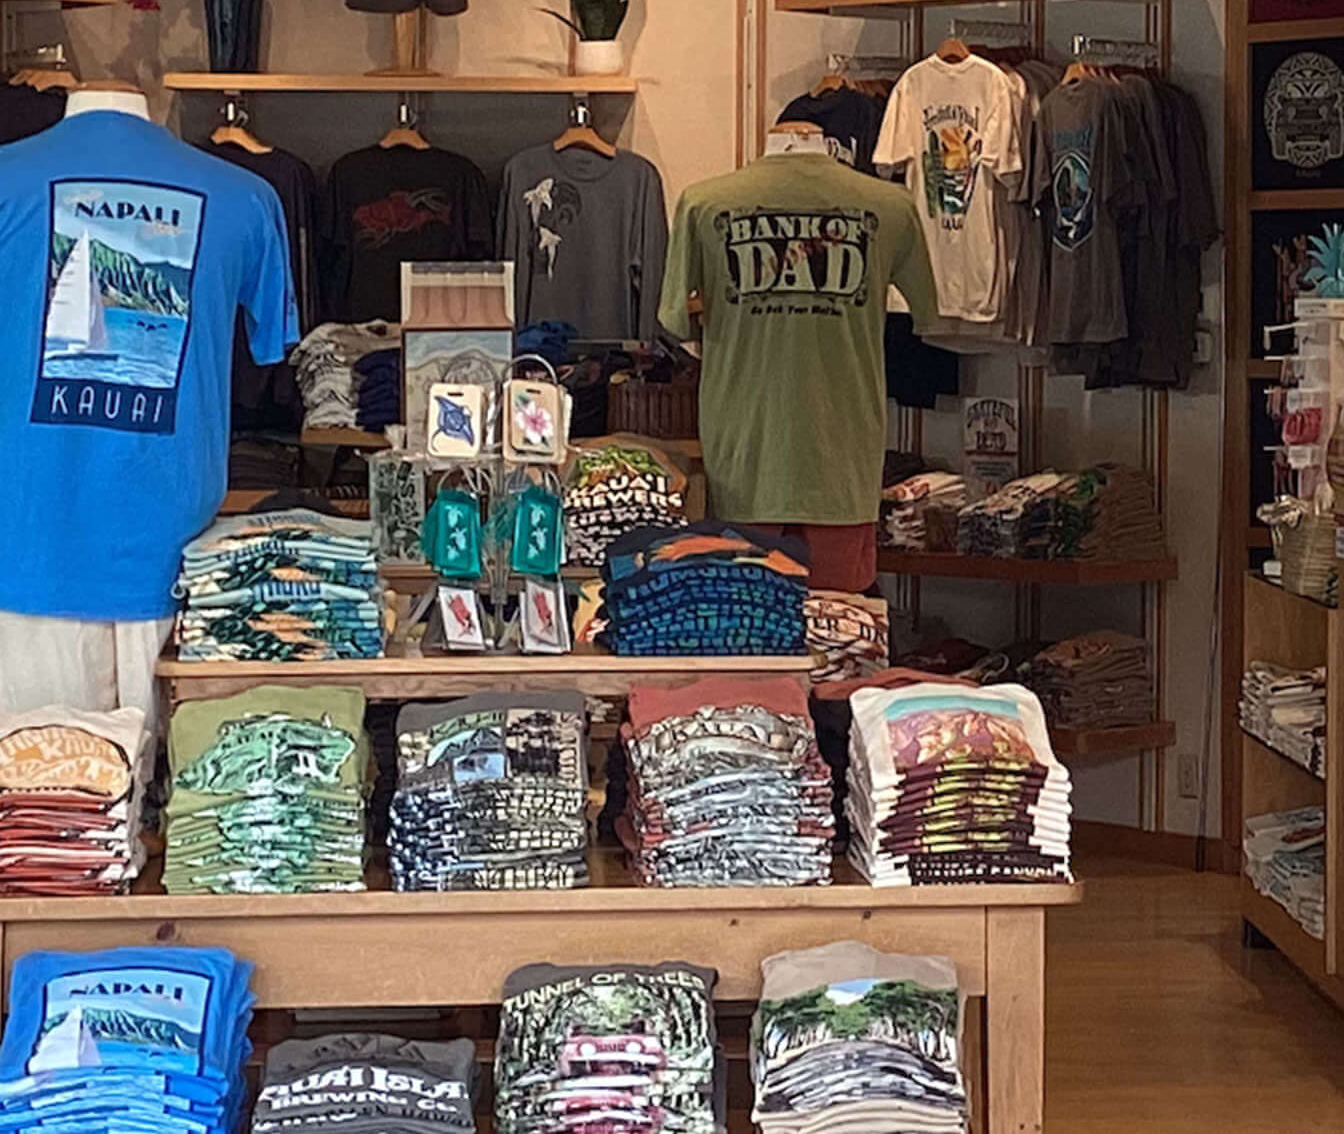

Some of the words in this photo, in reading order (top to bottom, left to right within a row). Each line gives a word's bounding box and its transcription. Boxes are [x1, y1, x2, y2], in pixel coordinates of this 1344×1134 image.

[74, 200, 181, 227] NAPALI
[731, 216, 821, 243] BANK
[825, 217, 865, 243] OF
[729, 240, 865, 295] DAD
[51, 384, 163, 424] KAUAI
[503, 978, 585, 1014] TUNNEL
[591, 973, 627, 984] OF
